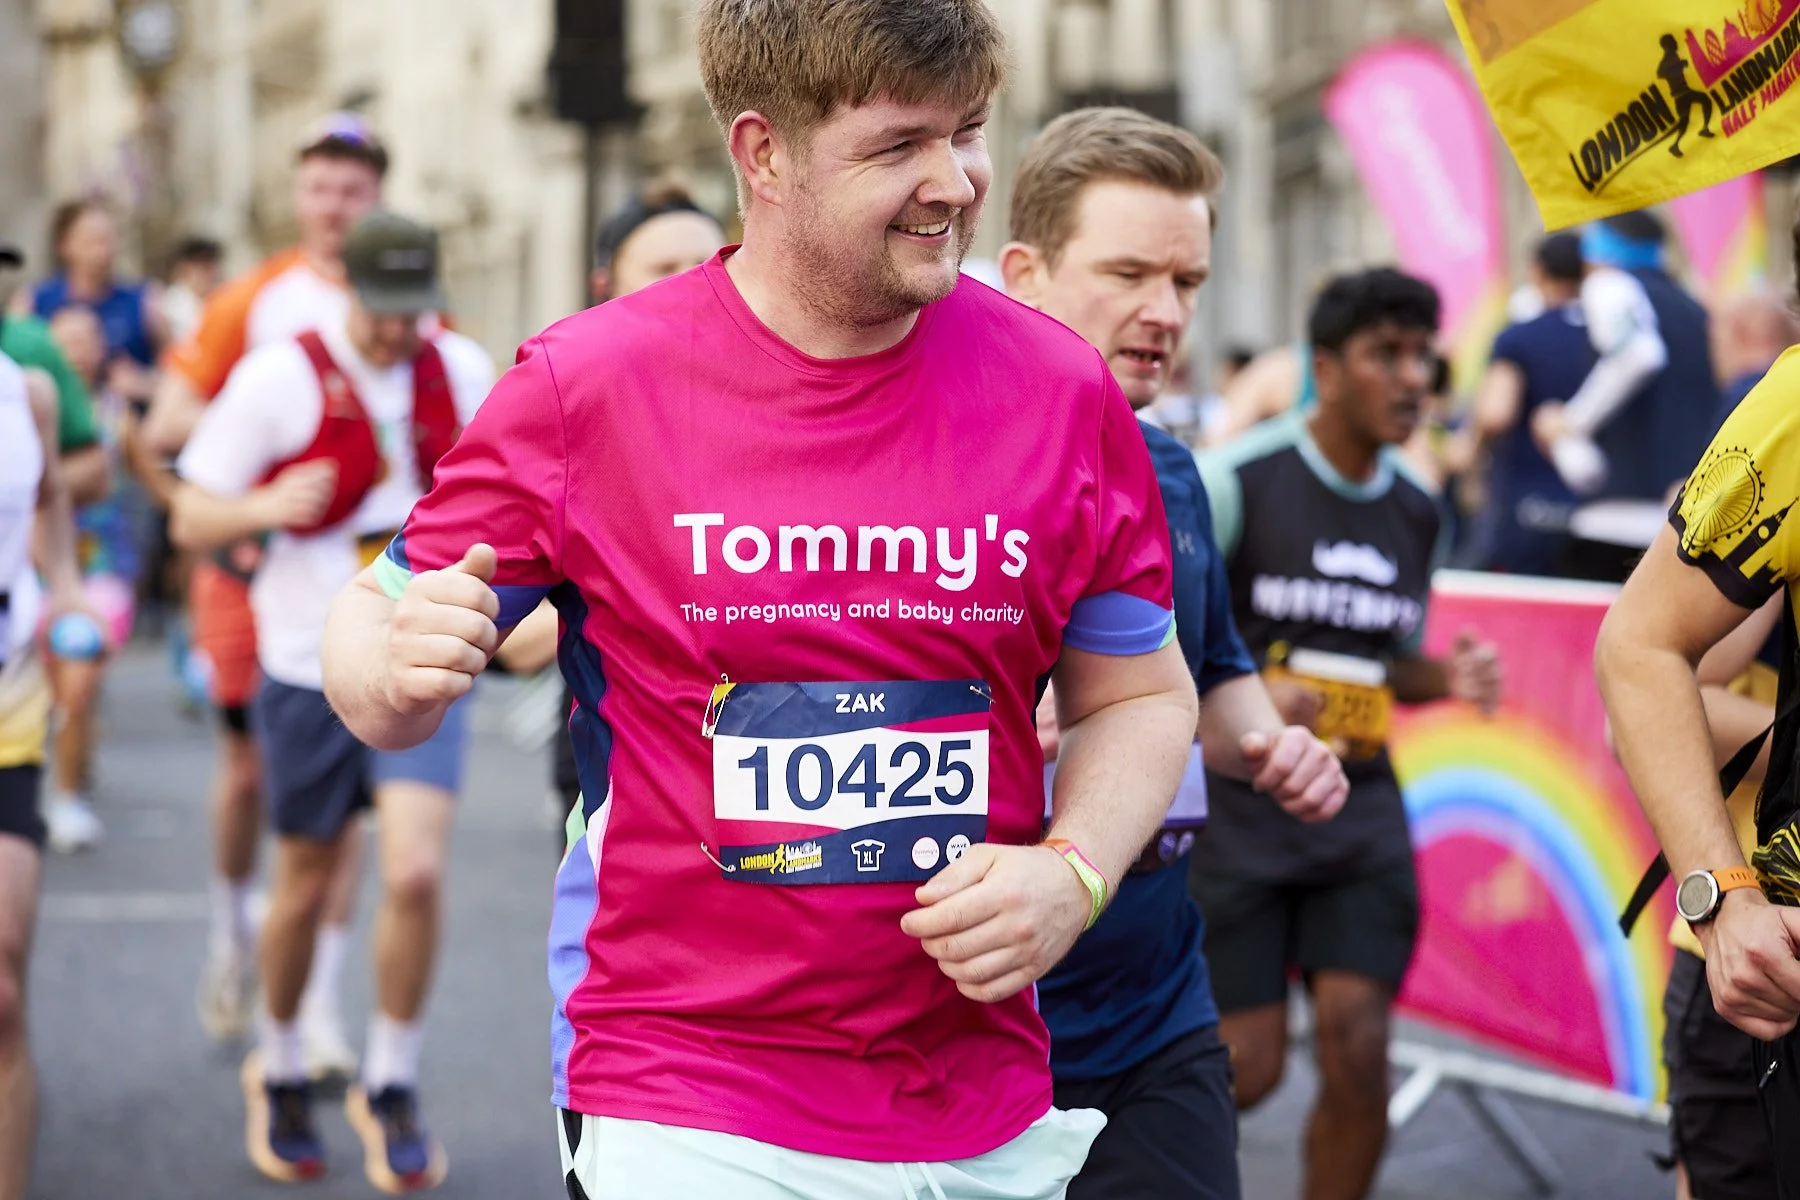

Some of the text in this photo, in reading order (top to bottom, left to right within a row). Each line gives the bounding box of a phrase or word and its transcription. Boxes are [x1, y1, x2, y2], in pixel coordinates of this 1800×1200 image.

[1569, 83, 1675, 193] LONDON
[1710, 7, 1800, 116] LANDMARK
[1721, 94, 1757, 138] HALF
[673, 512, 1030, 592] Tommy's
[680, 598, 1025, 625] The pregnancy and baby charity
[835, 692, 886, 714] ZAK
[738, 739, 974, 811] 10425
[740, 852, 775, 869] LONDON
[863, 851, 874, 865] XL
